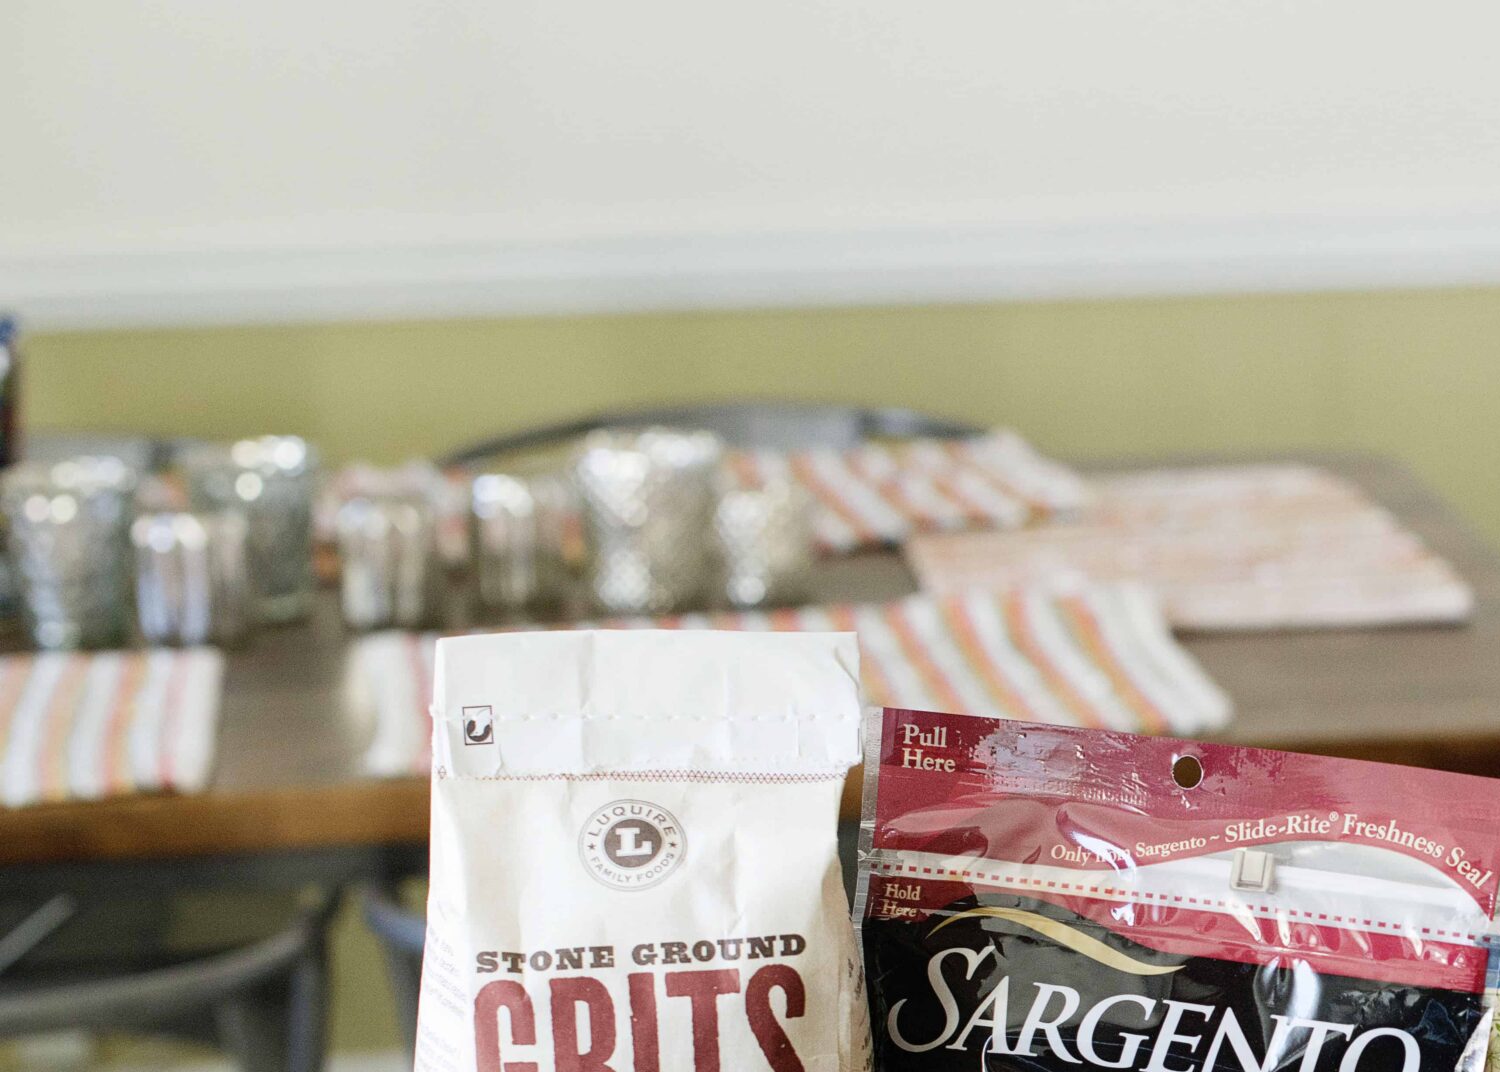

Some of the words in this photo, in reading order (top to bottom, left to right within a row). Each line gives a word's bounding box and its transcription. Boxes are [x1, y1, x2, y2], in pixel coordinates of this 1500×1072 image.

[903, 723, 947, 748] Pull
[902, 748, 956, 773] Here
[588, 805, 677, 837] LUQUIRE
[615, 827, 652, 857] L
[1051, 843, 1091, 866] Only
[1135, 836, 1207, 858] Sargento
[1342, 813, 1445, 859] Freshness
[1445, 846, 1495, 890] Seal
[590, 856, 632, 882] FAMILY
[637, 852, 675, 881] FOODS
[885, 883, 921, 901] Hold
[882, 901, 918, 917] Here
[476, 946, 615, 974] STONE
[631, 933, 806, 966] GROUND
